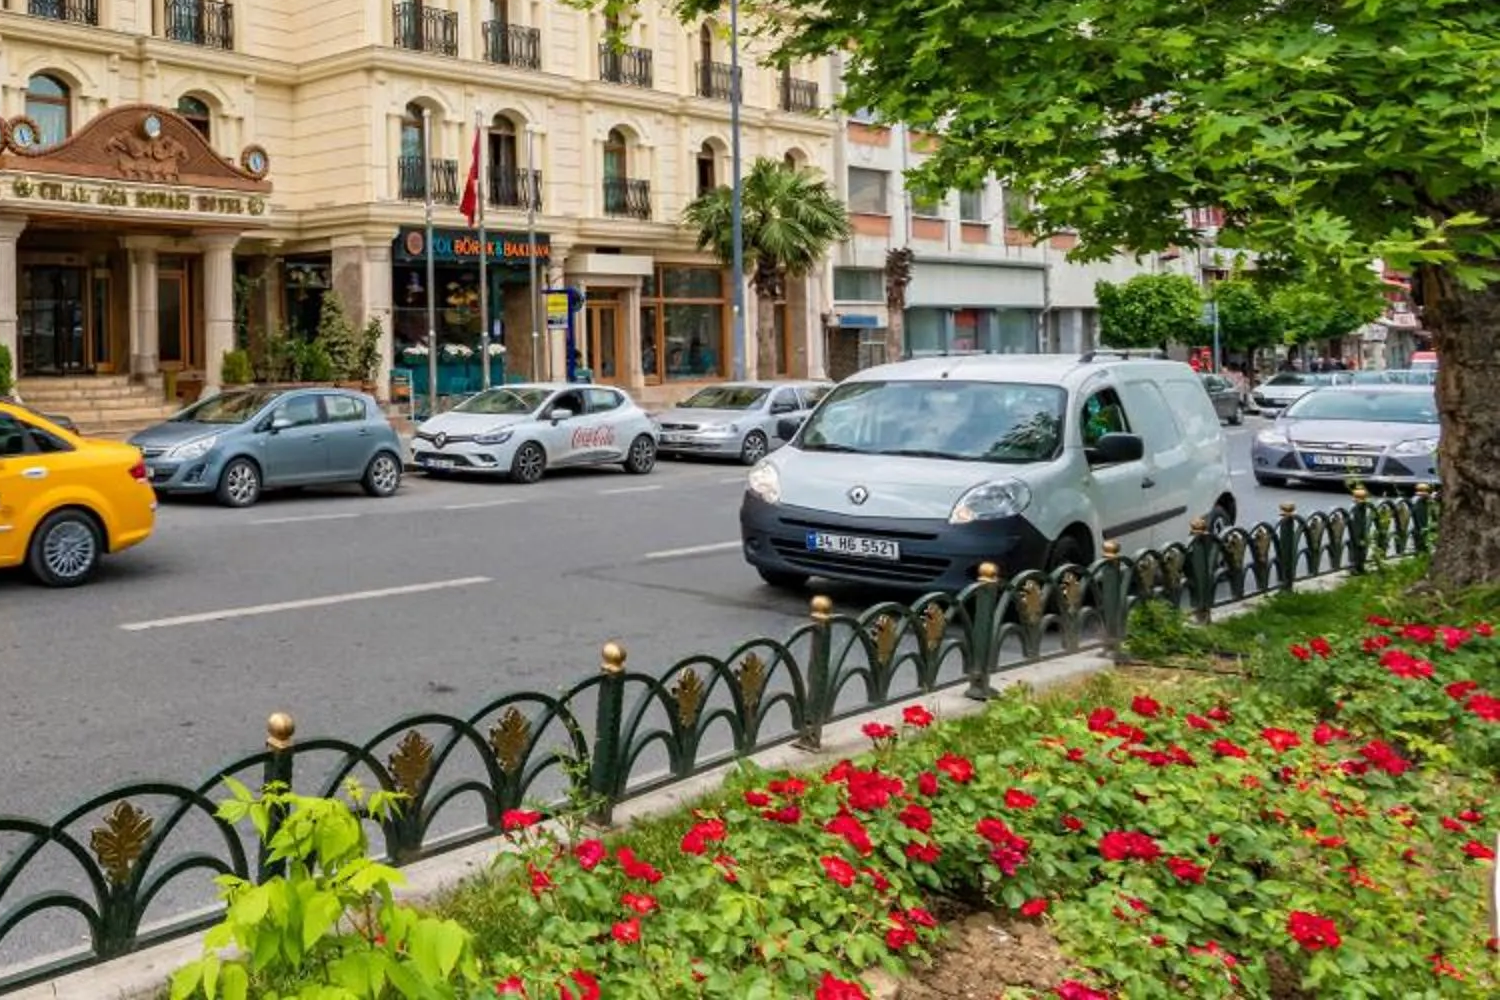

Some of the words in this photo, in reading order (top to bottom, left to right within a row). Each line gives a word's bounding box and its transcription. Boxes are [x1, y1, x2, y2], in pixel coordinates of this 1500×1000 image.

[454, 236, 495, 256] BÖRK
[504, 241, 549, 257] BAKLVA
[817, 535, 833, 549] 34
